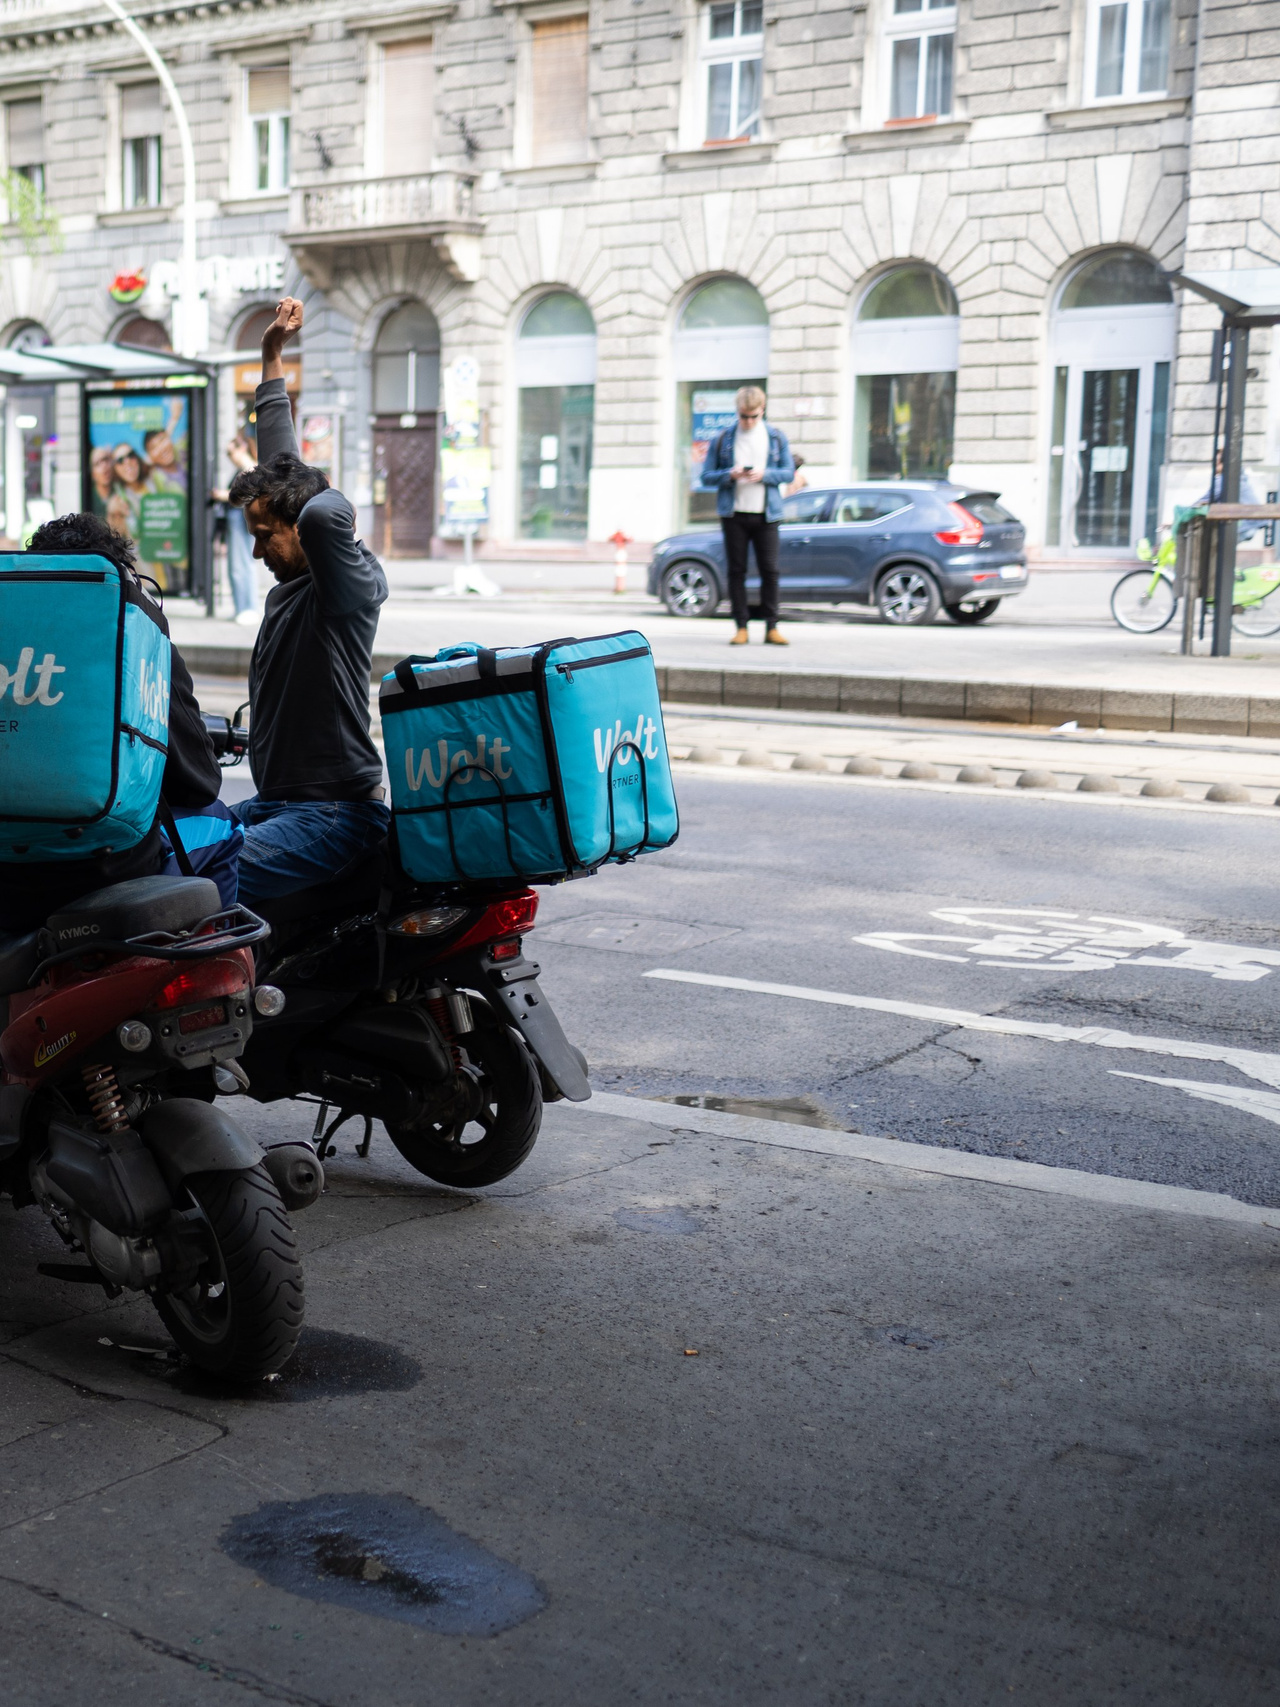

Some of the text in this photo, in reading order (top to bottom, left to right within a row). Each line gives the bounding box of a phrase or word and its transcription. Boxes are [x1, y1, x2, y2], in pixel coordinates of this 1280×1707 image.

[405, 734, 513, 791] Wolt
[593, 714, 659, 774] Wolt
[58, 924, 100, 940] KYMCO
